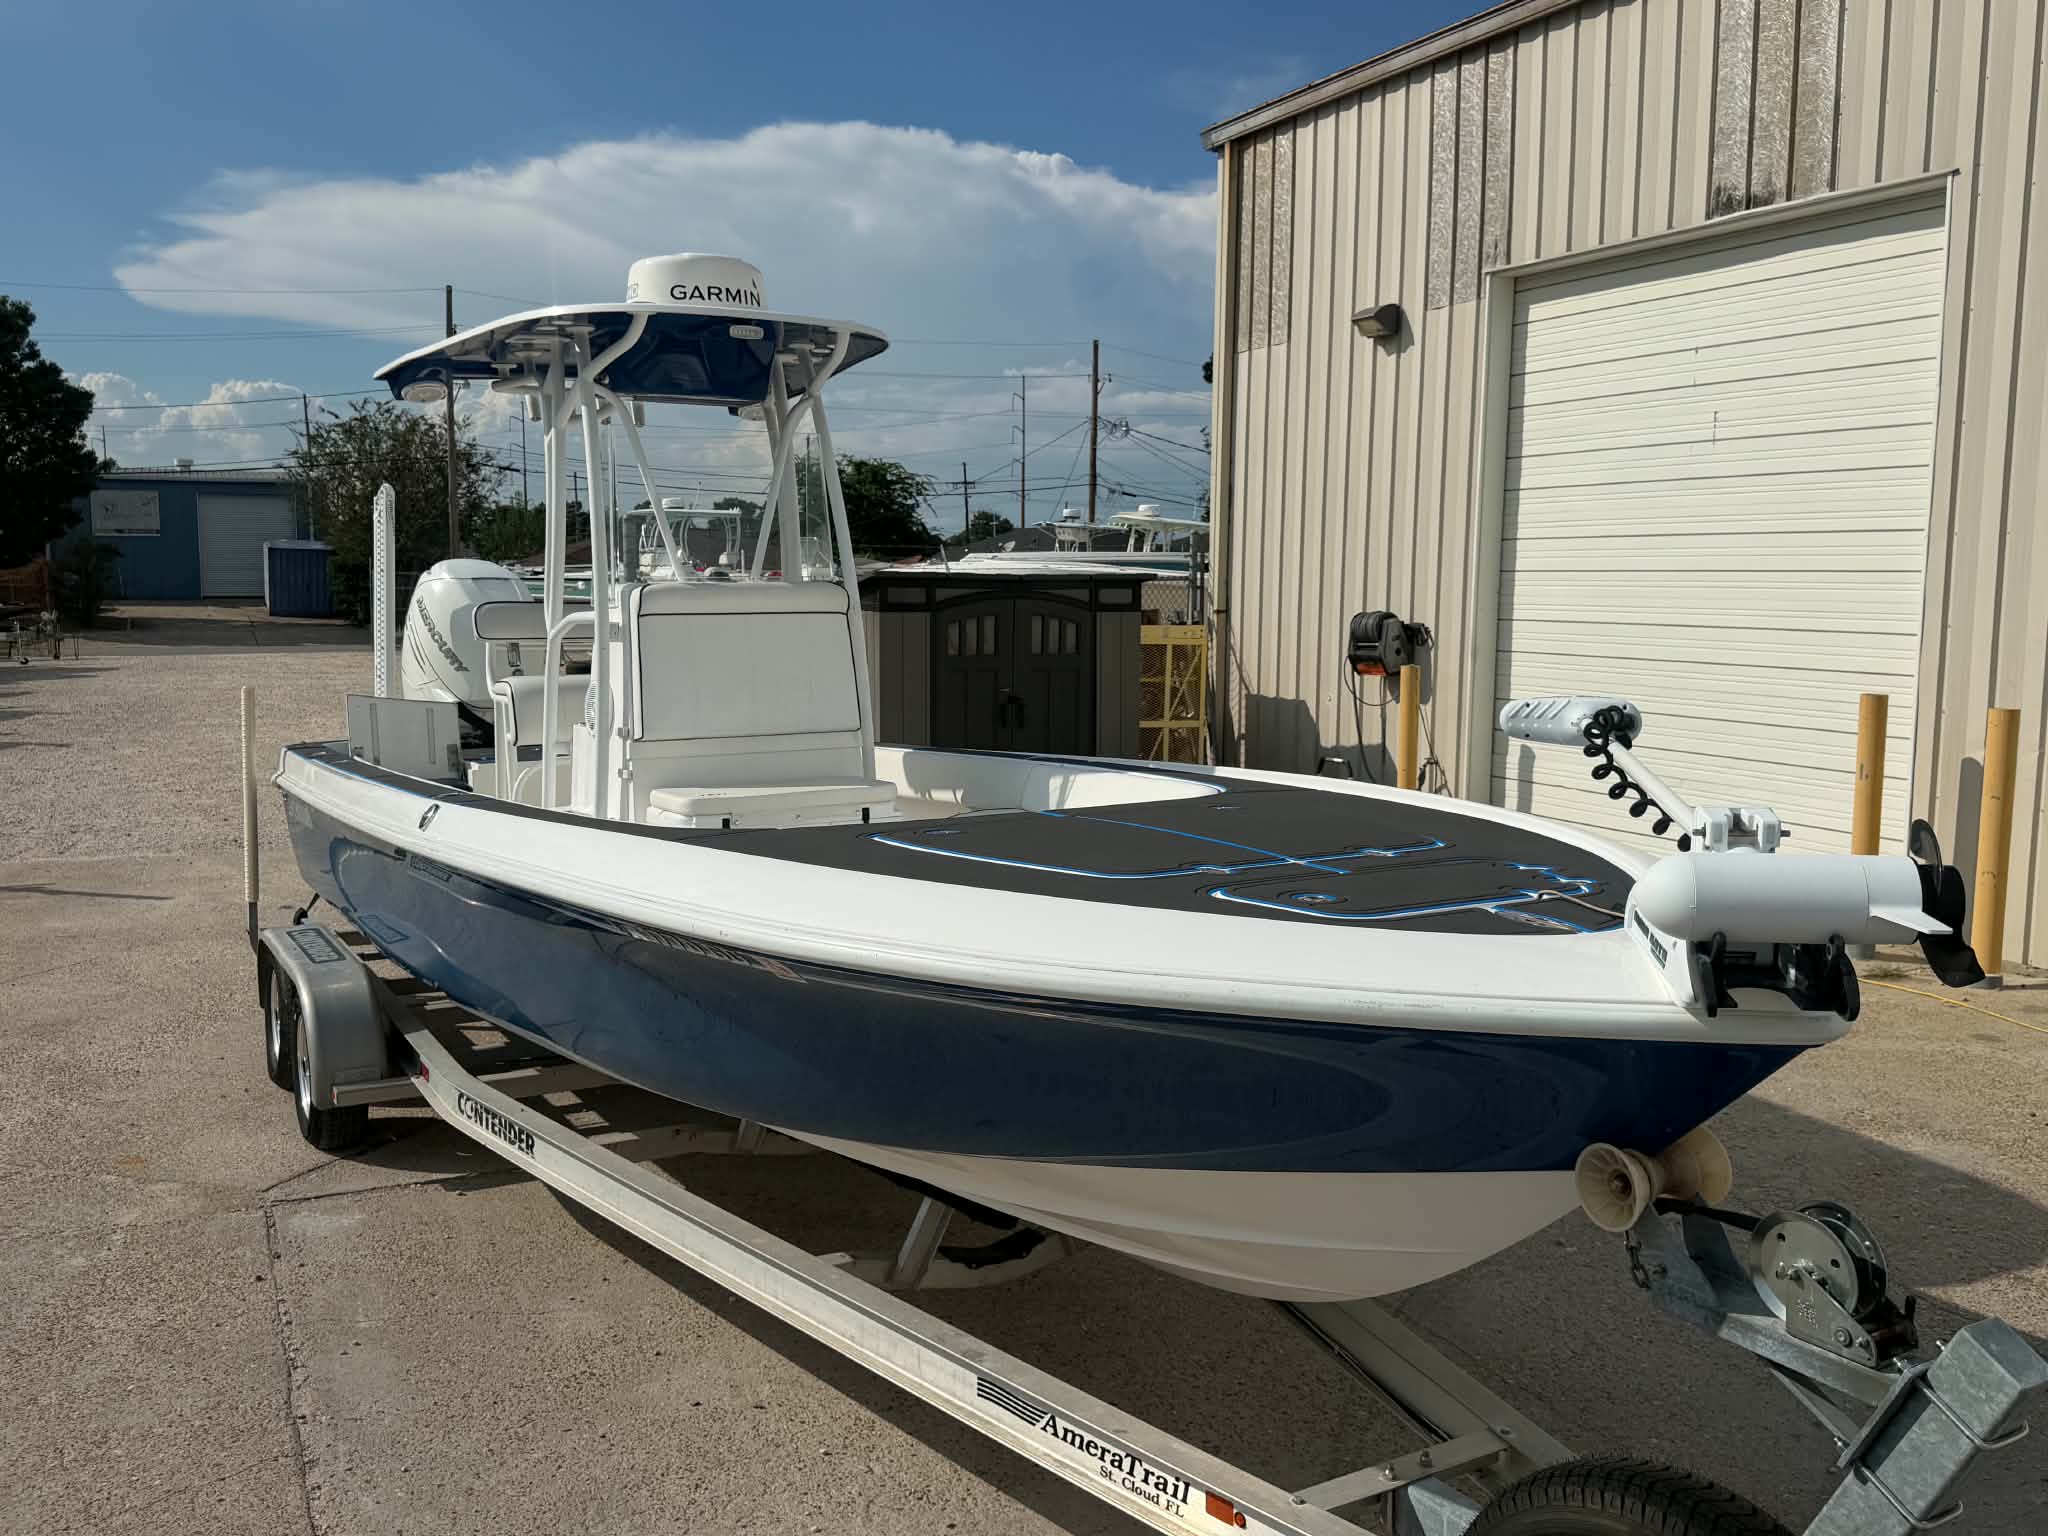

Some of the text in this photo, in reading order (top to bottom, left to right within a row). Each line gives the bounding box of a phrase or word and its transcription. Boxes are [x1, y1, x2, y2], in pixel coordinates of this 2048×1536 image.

[670, 284, 761, 307] GARMIN
[457, 1091, 536, 1159] CONTENDER
[1040, 1414, 1191, 1505] AmeraTrail
[1099, 1465, 1185, 1518] St. Cloud FL
